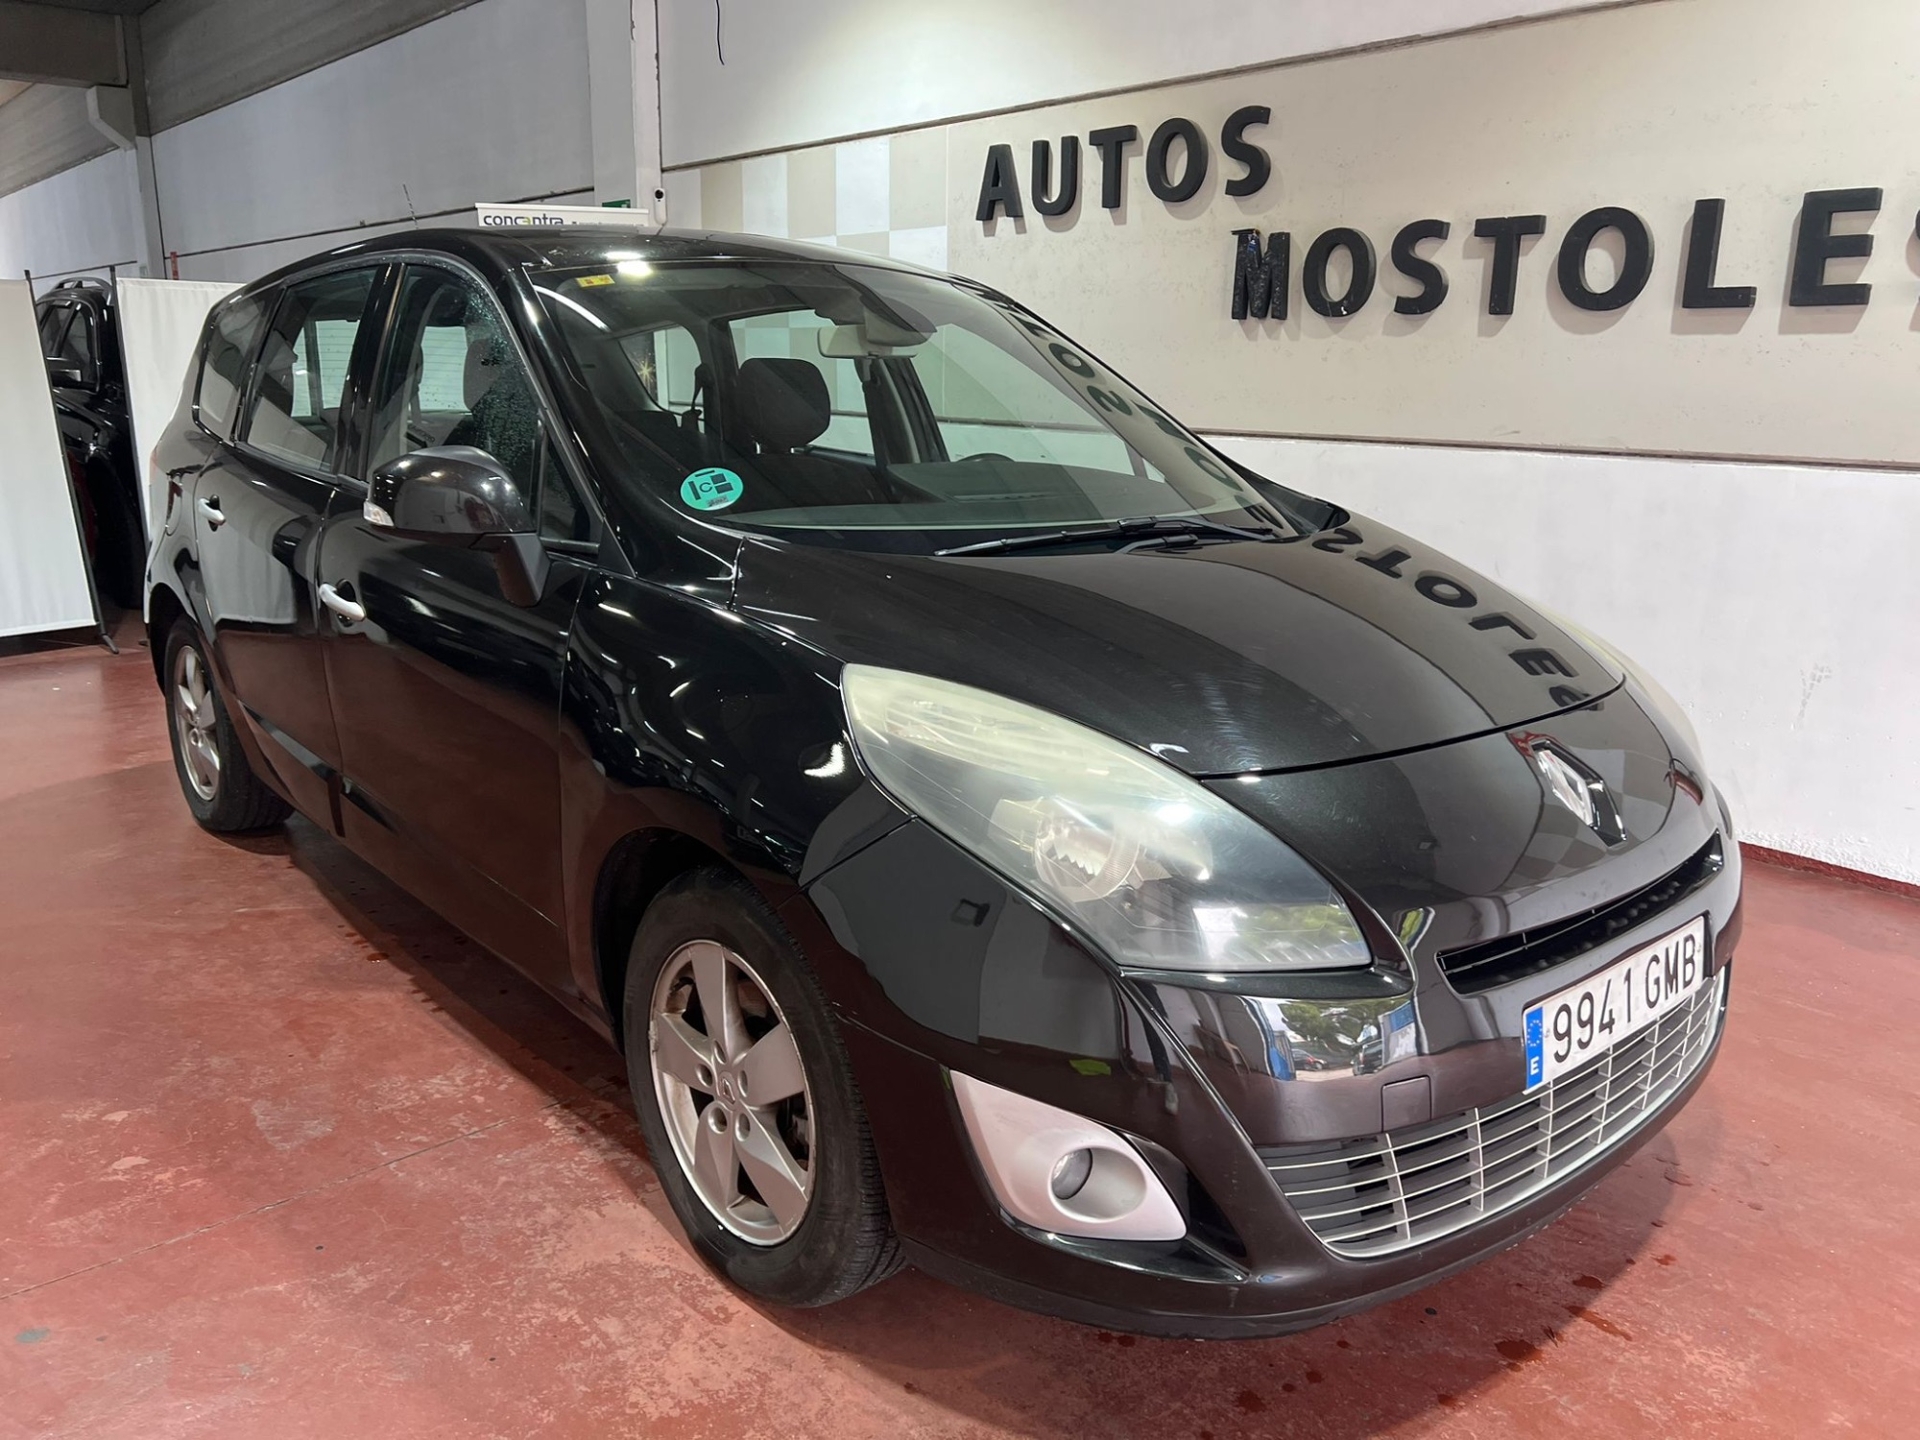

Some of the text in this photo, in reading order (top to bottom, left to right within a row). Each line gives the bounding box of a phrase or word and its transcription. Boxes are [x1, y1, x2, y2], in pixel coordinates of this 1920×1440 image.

[975, 105, 1271, 222] AUTOS
[1230, 187, 1920, 321] MOSTOLE
[1553, 933, 1696, 1063] 9941 GMB
[1530, 1056, 1539, 1075] E
